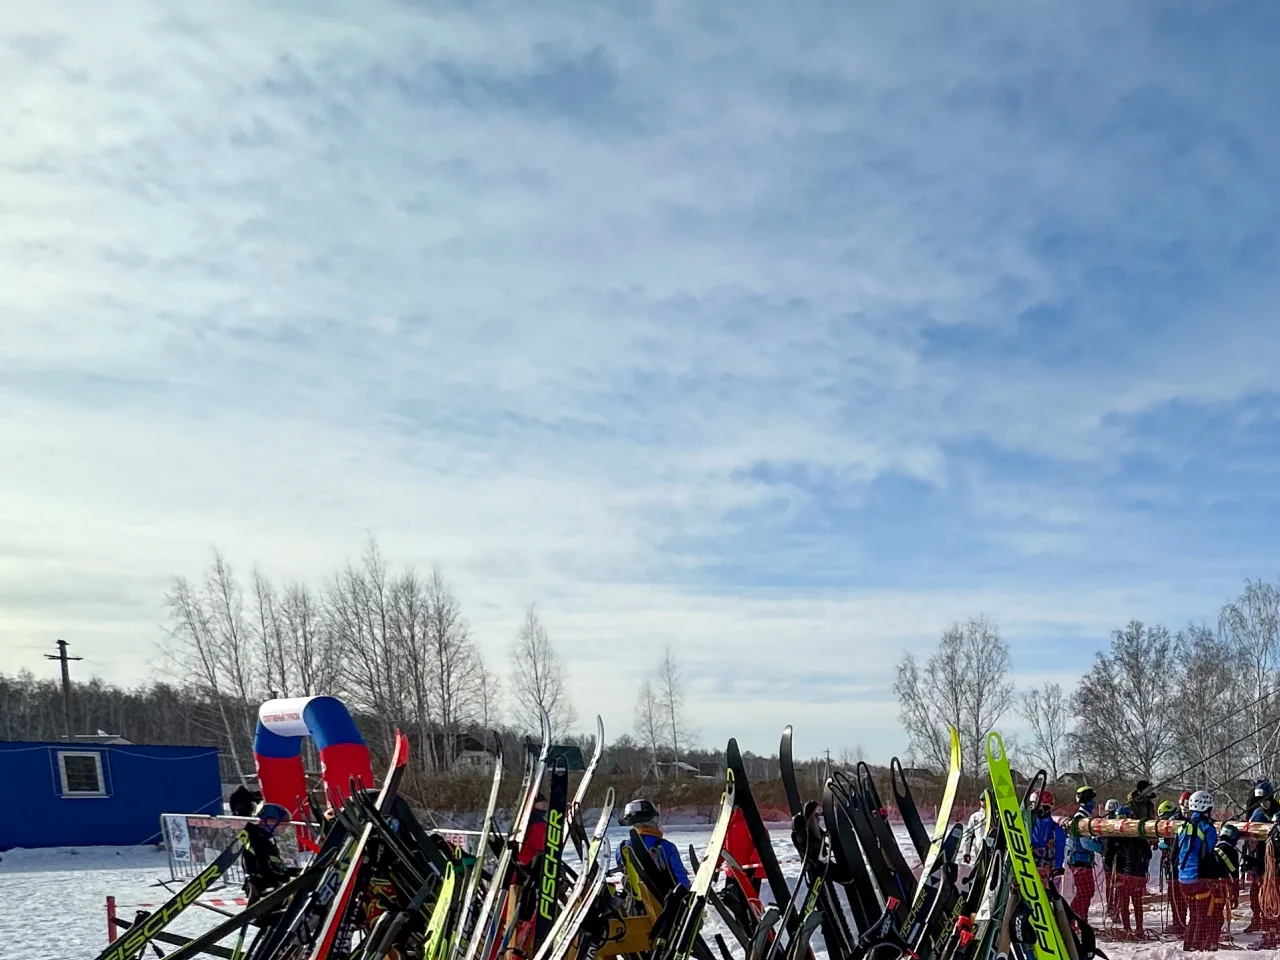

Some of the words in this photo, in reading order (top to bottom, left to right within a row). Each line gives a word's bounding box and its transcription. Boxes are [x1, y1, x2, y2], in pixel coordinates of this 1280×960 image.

[540, 809, 563, 920] FISCHER
[901, 888, 929, 943] FISCHER
[1004, 809, 1055, 955] FISCHER
